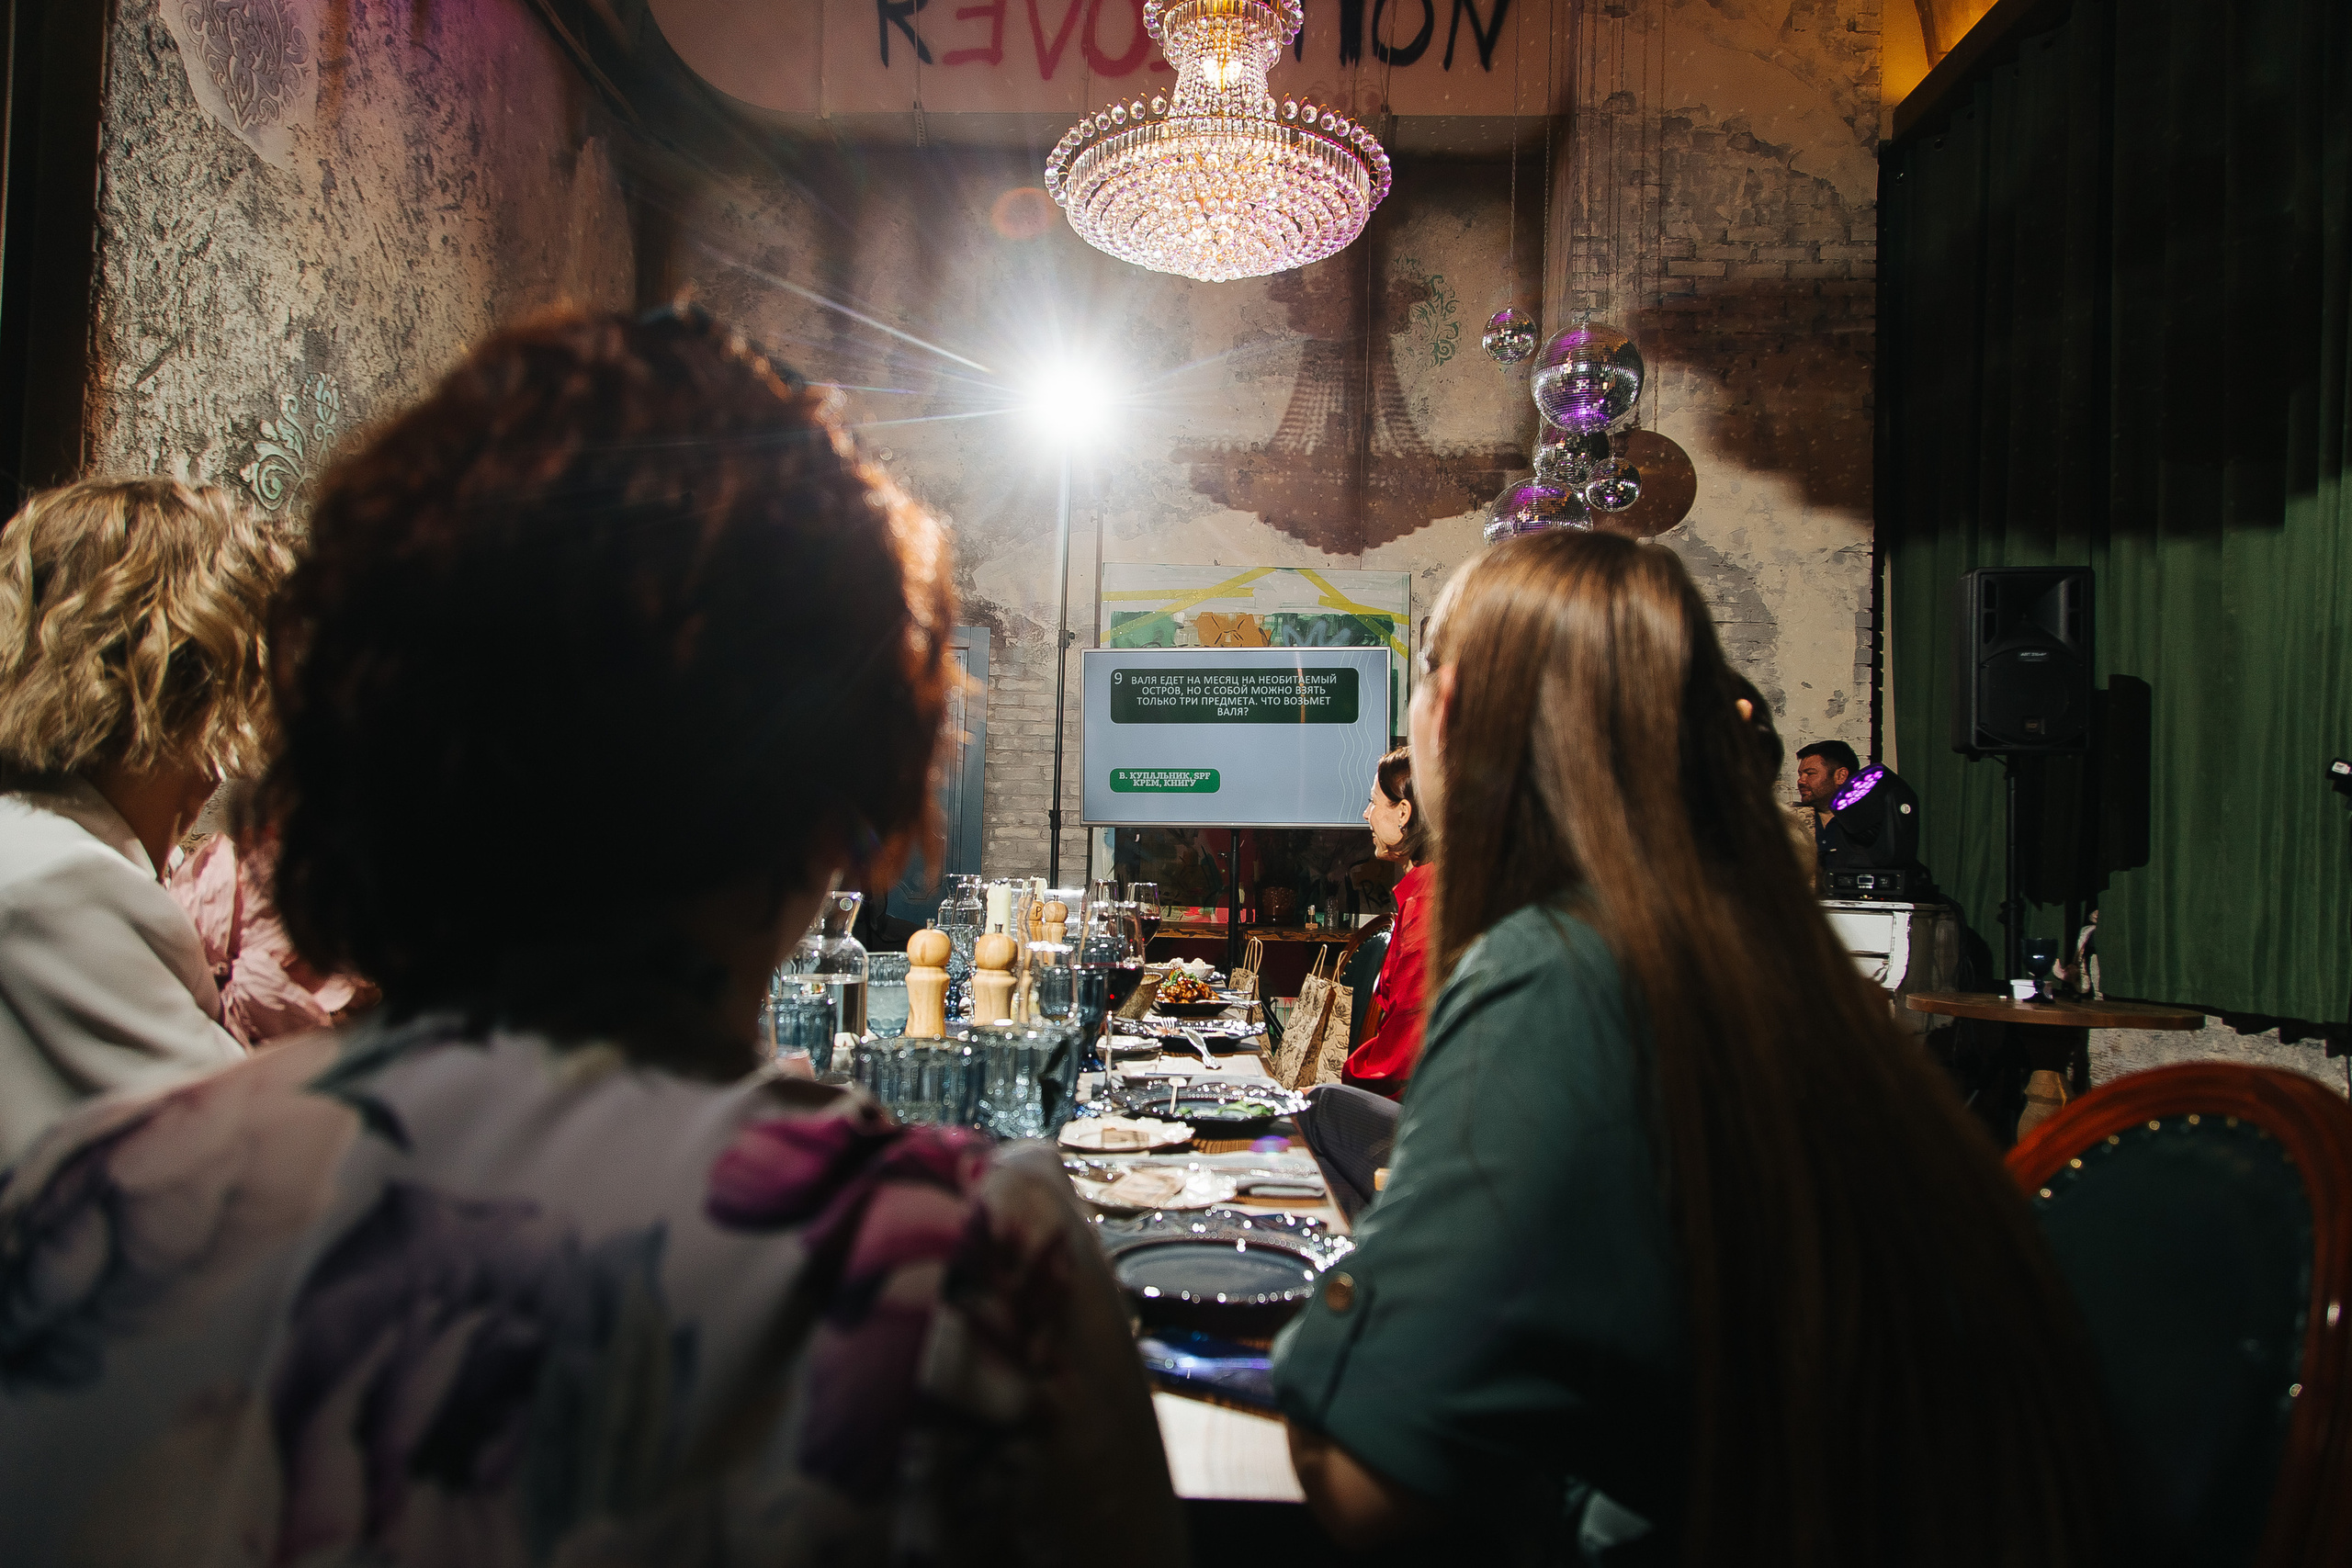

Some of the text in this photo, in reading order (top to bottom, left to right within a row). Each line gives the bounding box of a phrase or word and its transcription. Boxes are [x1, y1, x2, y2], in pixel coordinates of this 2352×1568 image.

[1114, 671, 1123, 685] 9
[1131, 673, 1337, 686] ВАЛЯ ЕДЕТ НА МЕСЯЦ НА НЕОБИТАЕМЫЙ
[1141, 684, 1326, 696] ОСТРОВ, НО С СОБОЙ МОЖНО ВЗЯТЬ
[1136, 696, 1331, 707] ТОЛЬКО ТРИ ПРЕДМЕТА. ЧТО ВОЗЬМЕТ
[1217, 706, 1250, 716] ВАЛЯ?
[1118, 772, 1212, 781] В. КУПАЛЬНИК, SPF
[1133, 779, 1197, 788] КРЕМ, КНИГУ
[1035, 906, 1042, 917] P
